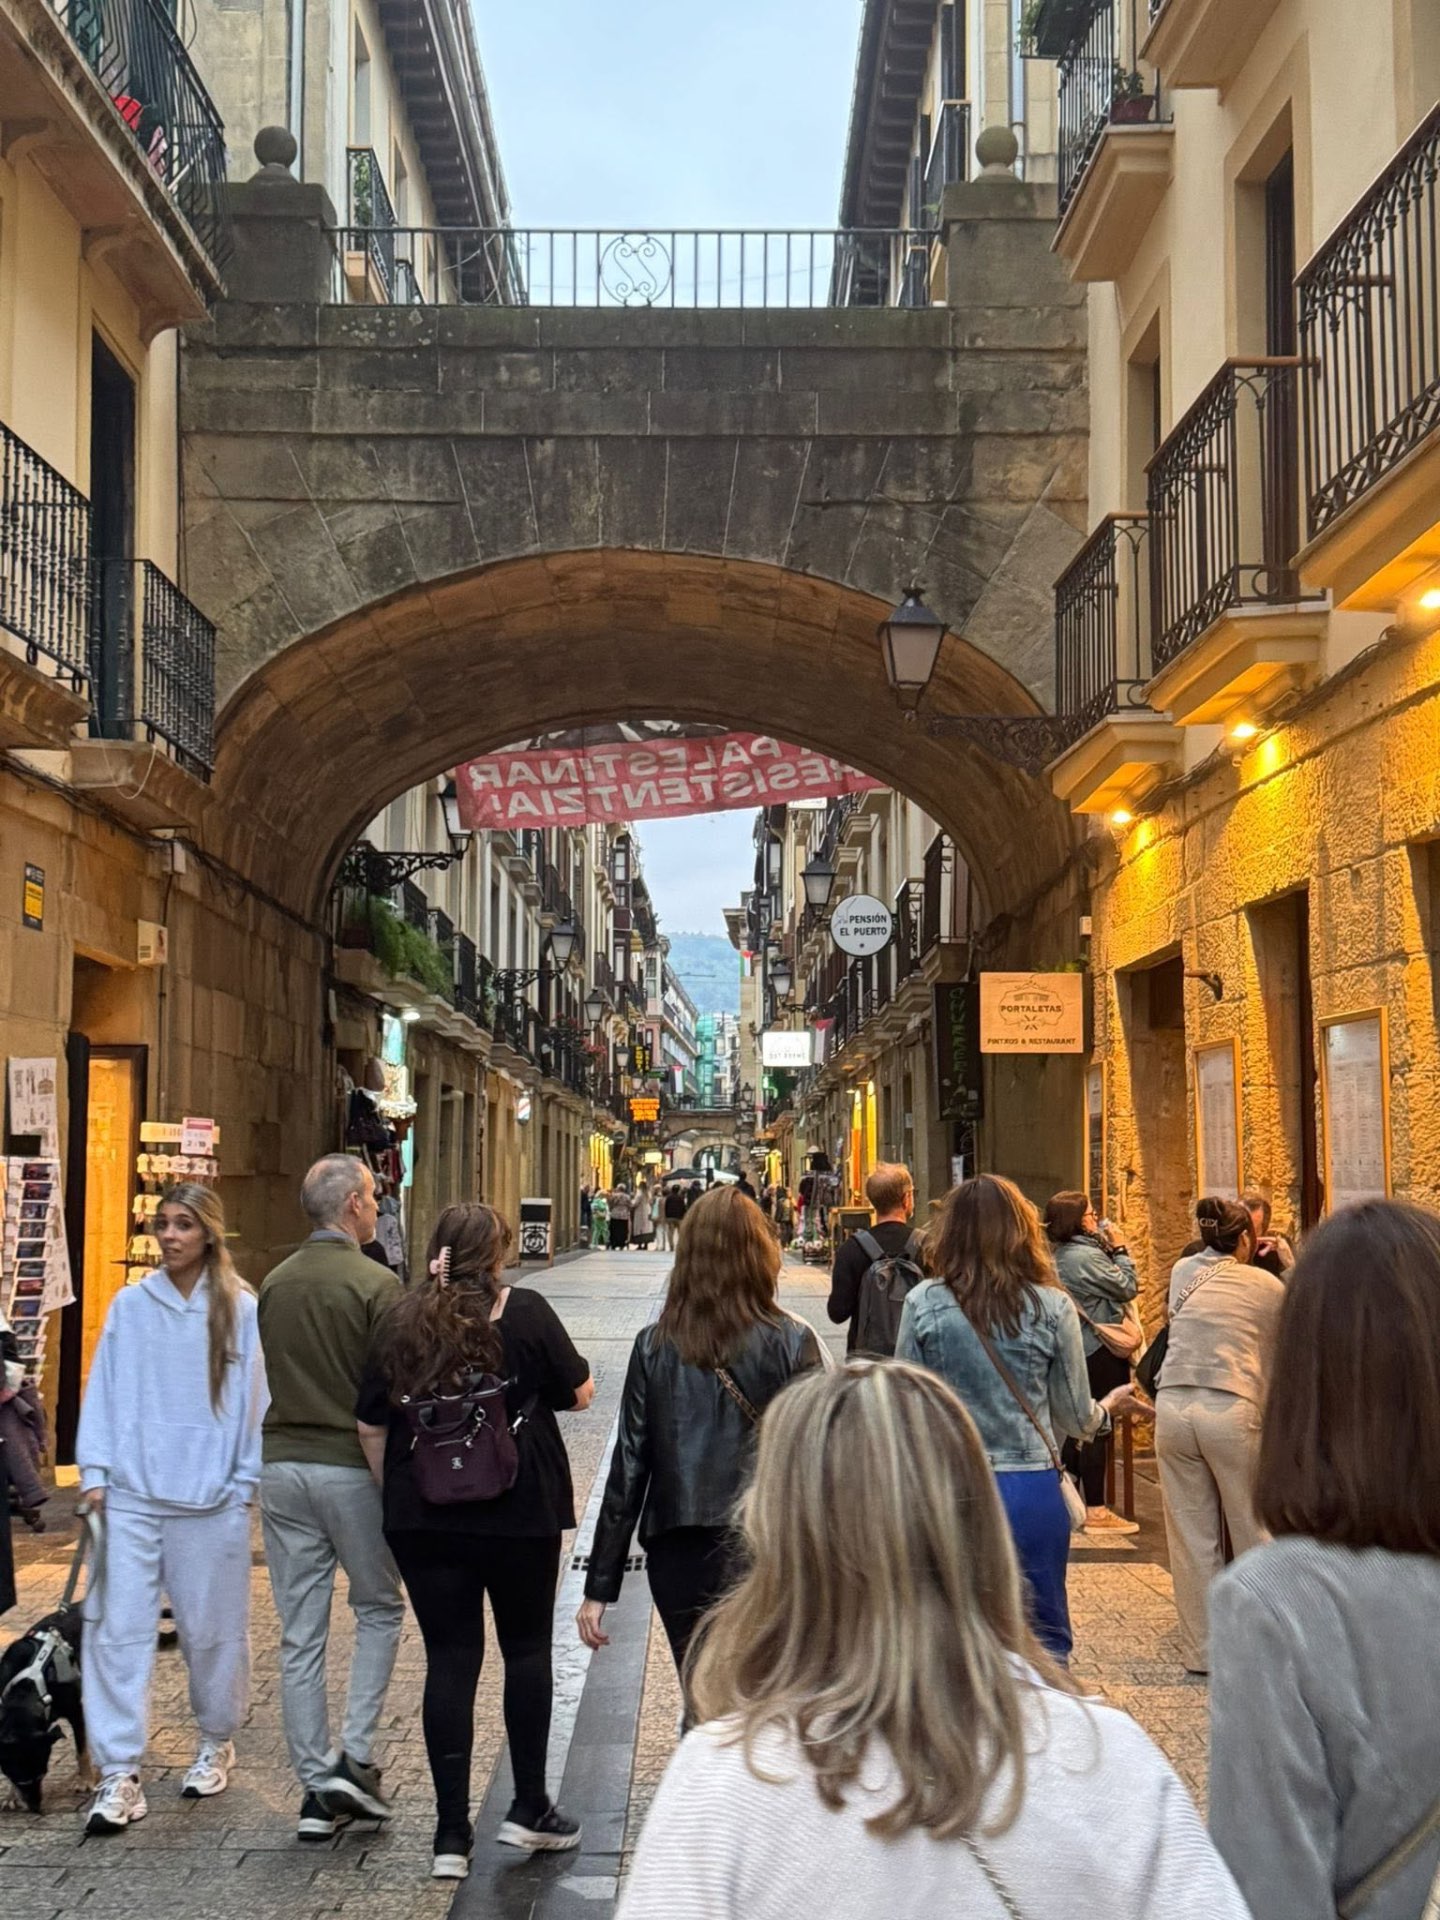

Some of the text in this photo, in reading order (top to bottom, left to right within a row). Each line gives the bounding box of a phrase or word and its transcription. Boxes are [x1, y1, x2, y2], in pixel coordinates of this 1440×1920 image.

[849, 912, 887, 924] PENSIÓN
[840, 926, 887, 936] EL PUERTO
[1001, 1005, 1062, 1013] PORTALETAS
